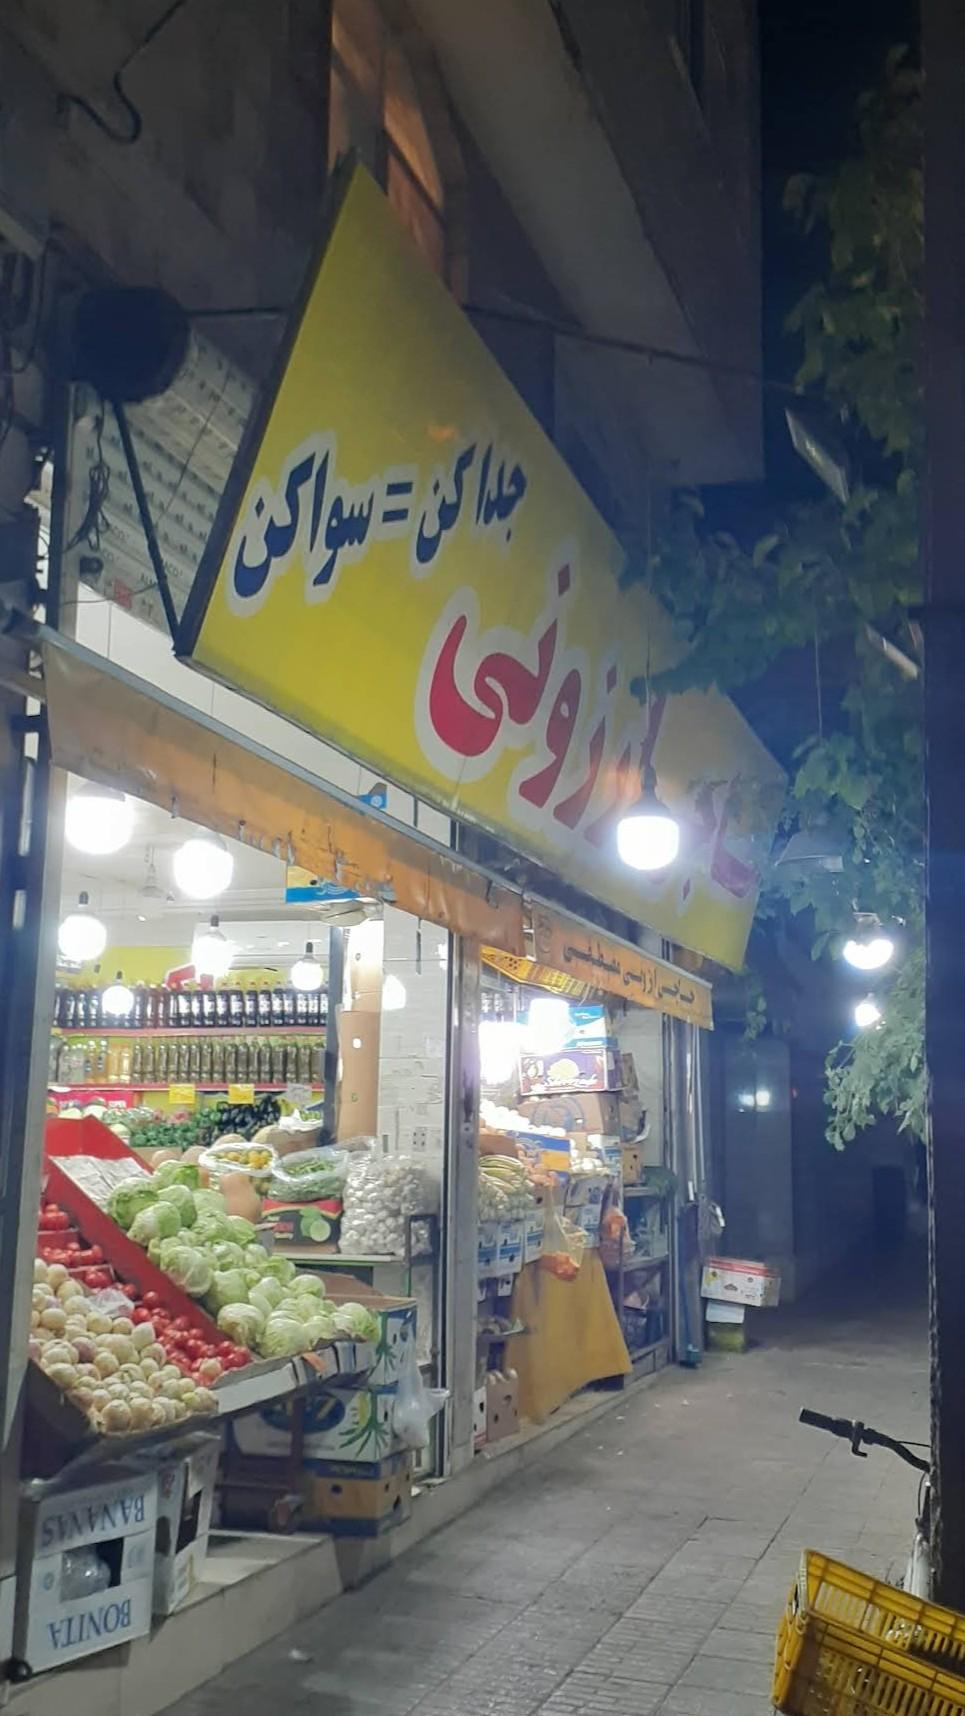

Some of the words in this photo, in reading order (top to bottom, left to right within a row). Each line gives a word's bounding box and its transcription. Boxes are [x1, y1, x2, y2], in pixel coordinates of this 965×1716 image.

[475, 443, 527, 543] جدا
[42, 1495, 146, 1548] BANANAS
[48, 1599, 132, 1650] BONITA
